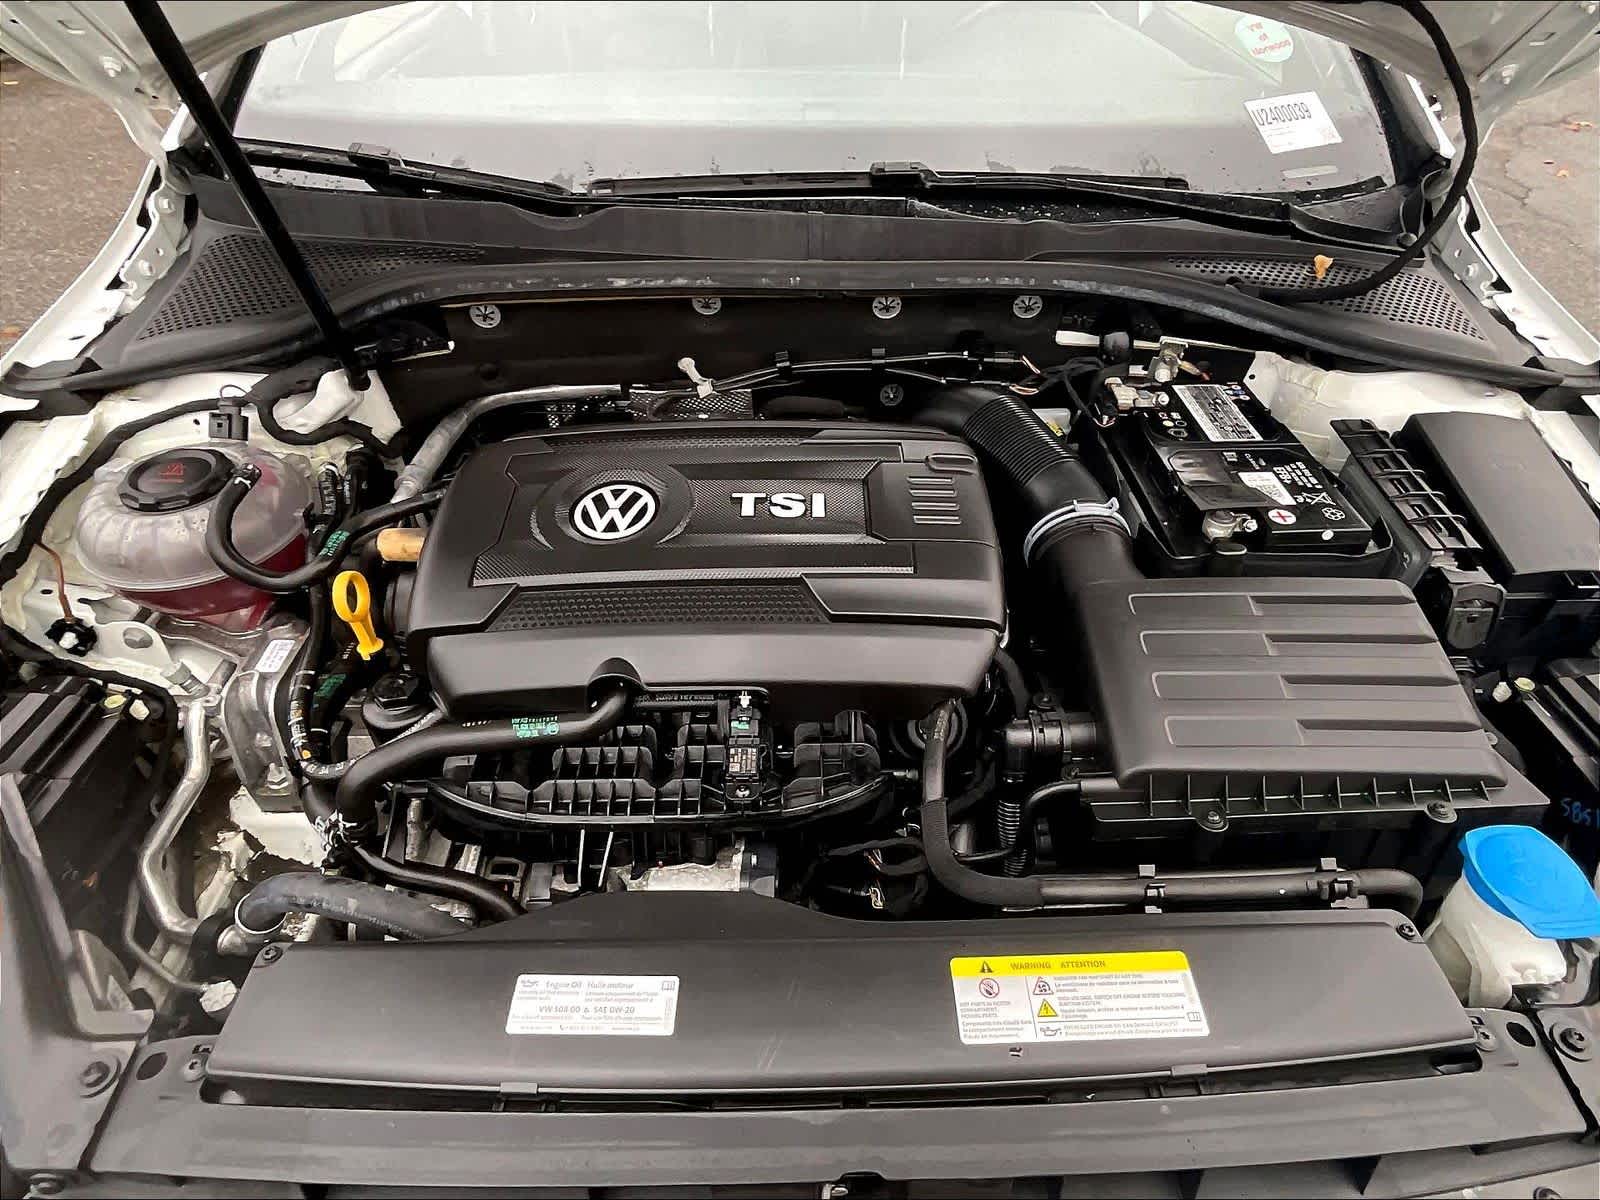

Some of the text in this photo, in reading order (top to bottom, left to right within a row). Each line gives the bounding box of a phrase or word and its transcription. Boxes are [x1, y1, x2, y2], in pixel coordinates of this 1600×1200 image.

[1252, 102, 1312, 126] U2400039
[731, 492, 826, 518] TSI
[1010, 960, 1106, 970] WARNING ATTENTION
